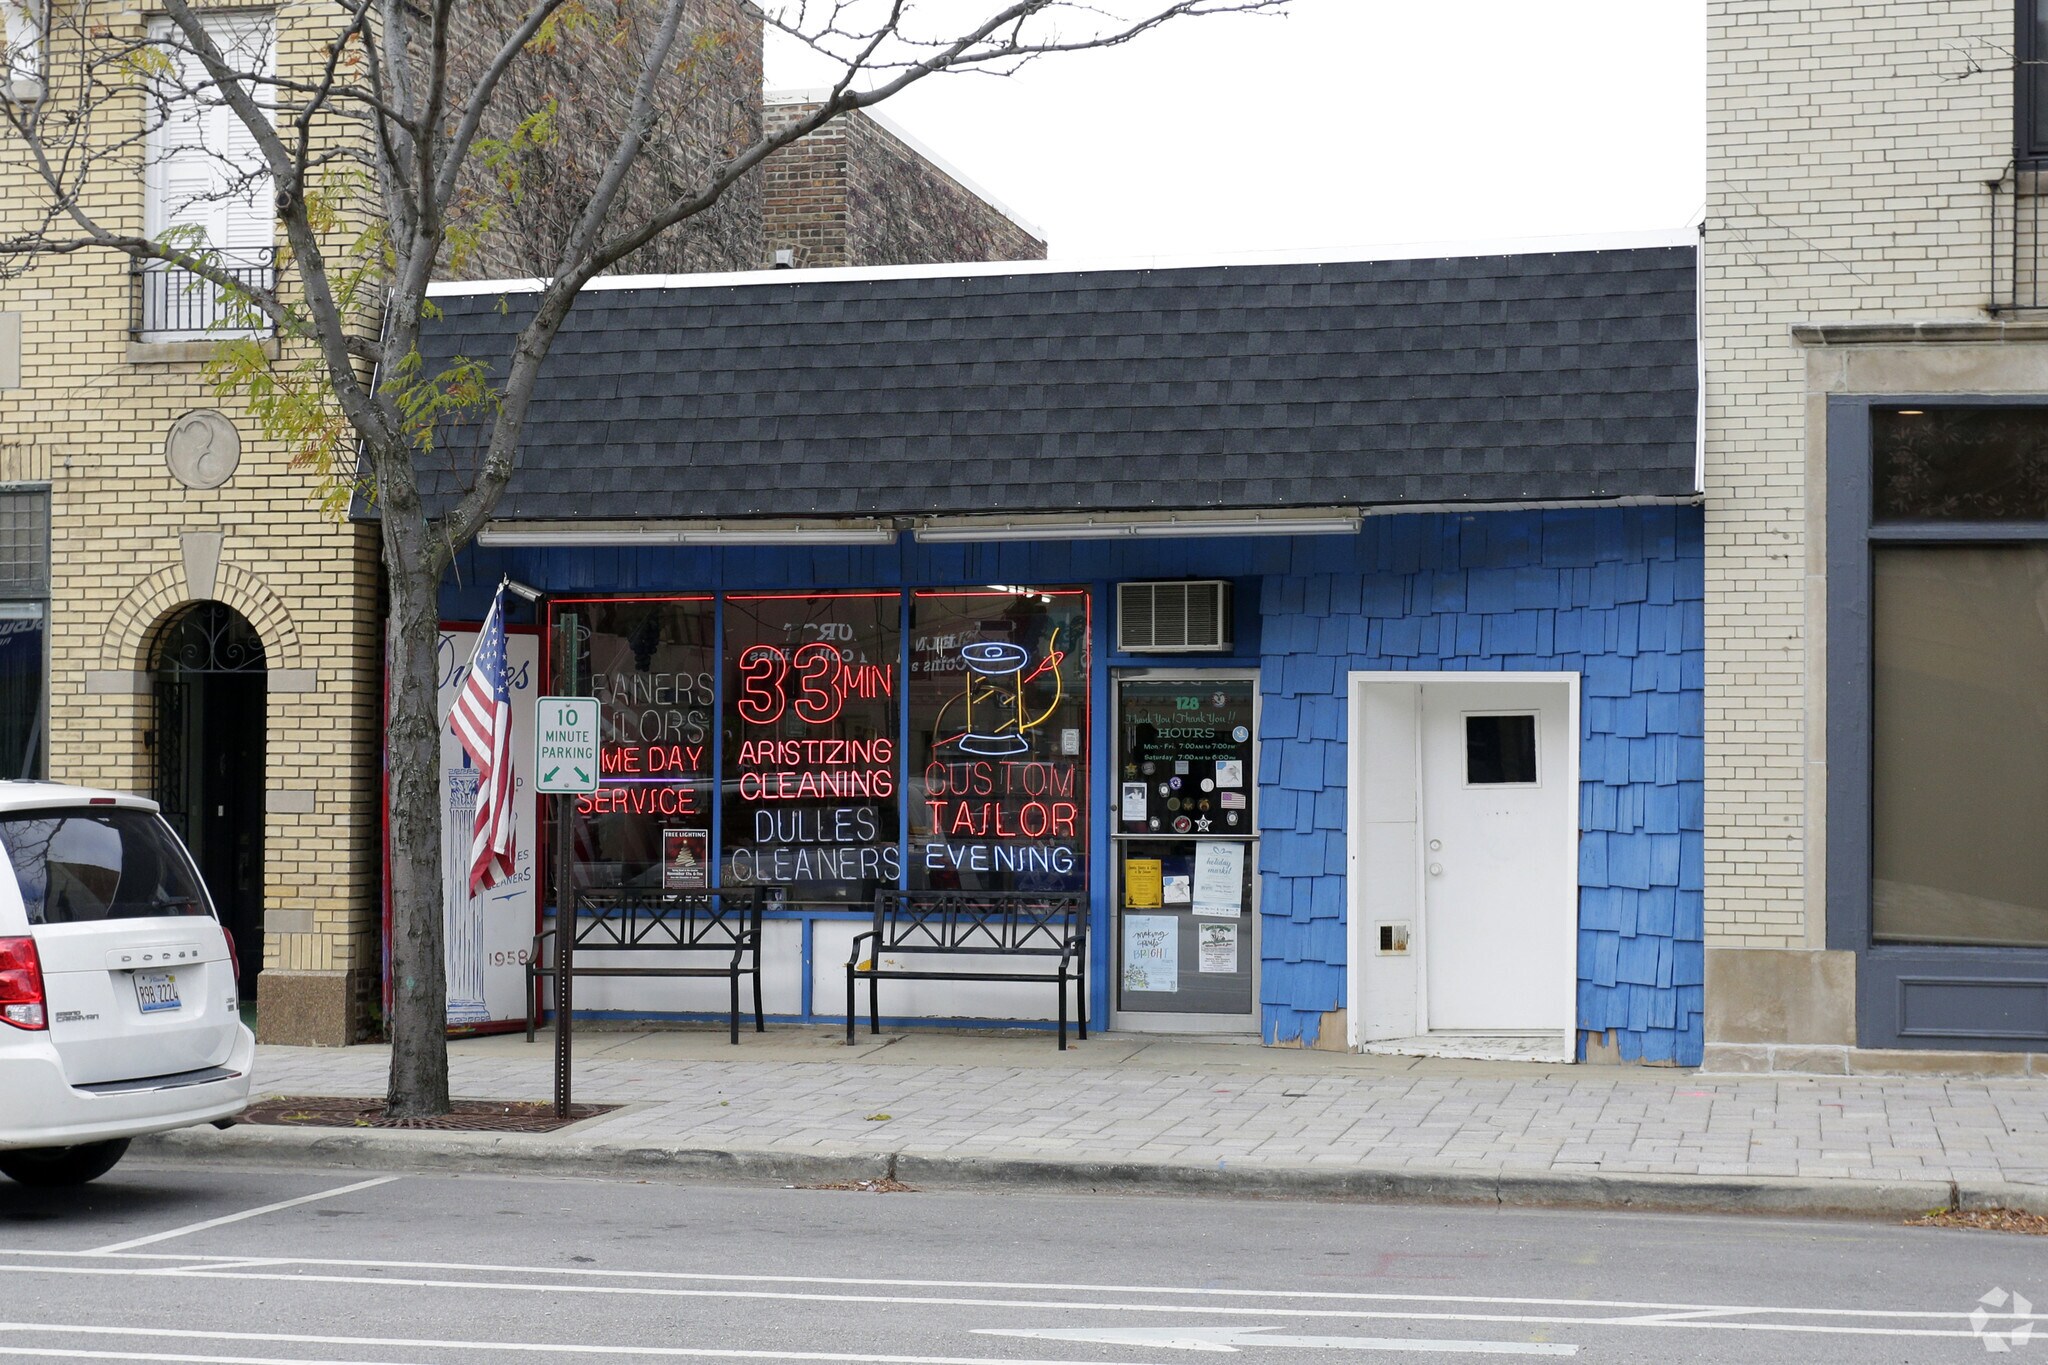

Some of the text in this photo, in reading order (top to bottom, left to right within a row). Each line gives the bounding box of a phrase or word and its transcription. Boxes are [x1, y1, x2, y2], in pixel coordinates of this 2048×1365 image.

[738, 642, 893, 724] 33 MIN
[1175, 696, 1200, 711] 128
[558, 709, 578, 726] 10
[1176, 711, 1206, 724] Thank
[545, 731, 589, 742] MINUTE
[1157, 727, 1215, 739] HOURS
[541, 747, 593, 759] PARKING
[601, 746, 703, 773] ME DAY
[738, 738, 893, 766] ARISTIZING
[739, 769, 893, 801] CLEANING
[925, 761, 1074, 798] CUSTOM
[577, 788, 696, 815] SERVICE
[755, 807, 877, 843] DULLES
[925, 801, 1077, 837] TAILOR
[732, 847, 901, 882] CLEANERS
[926, 843, 1073, 873] EVENING
[489, 949, 529, 966] 1958
[1134, 948, 1168, 959] BRIGHT
